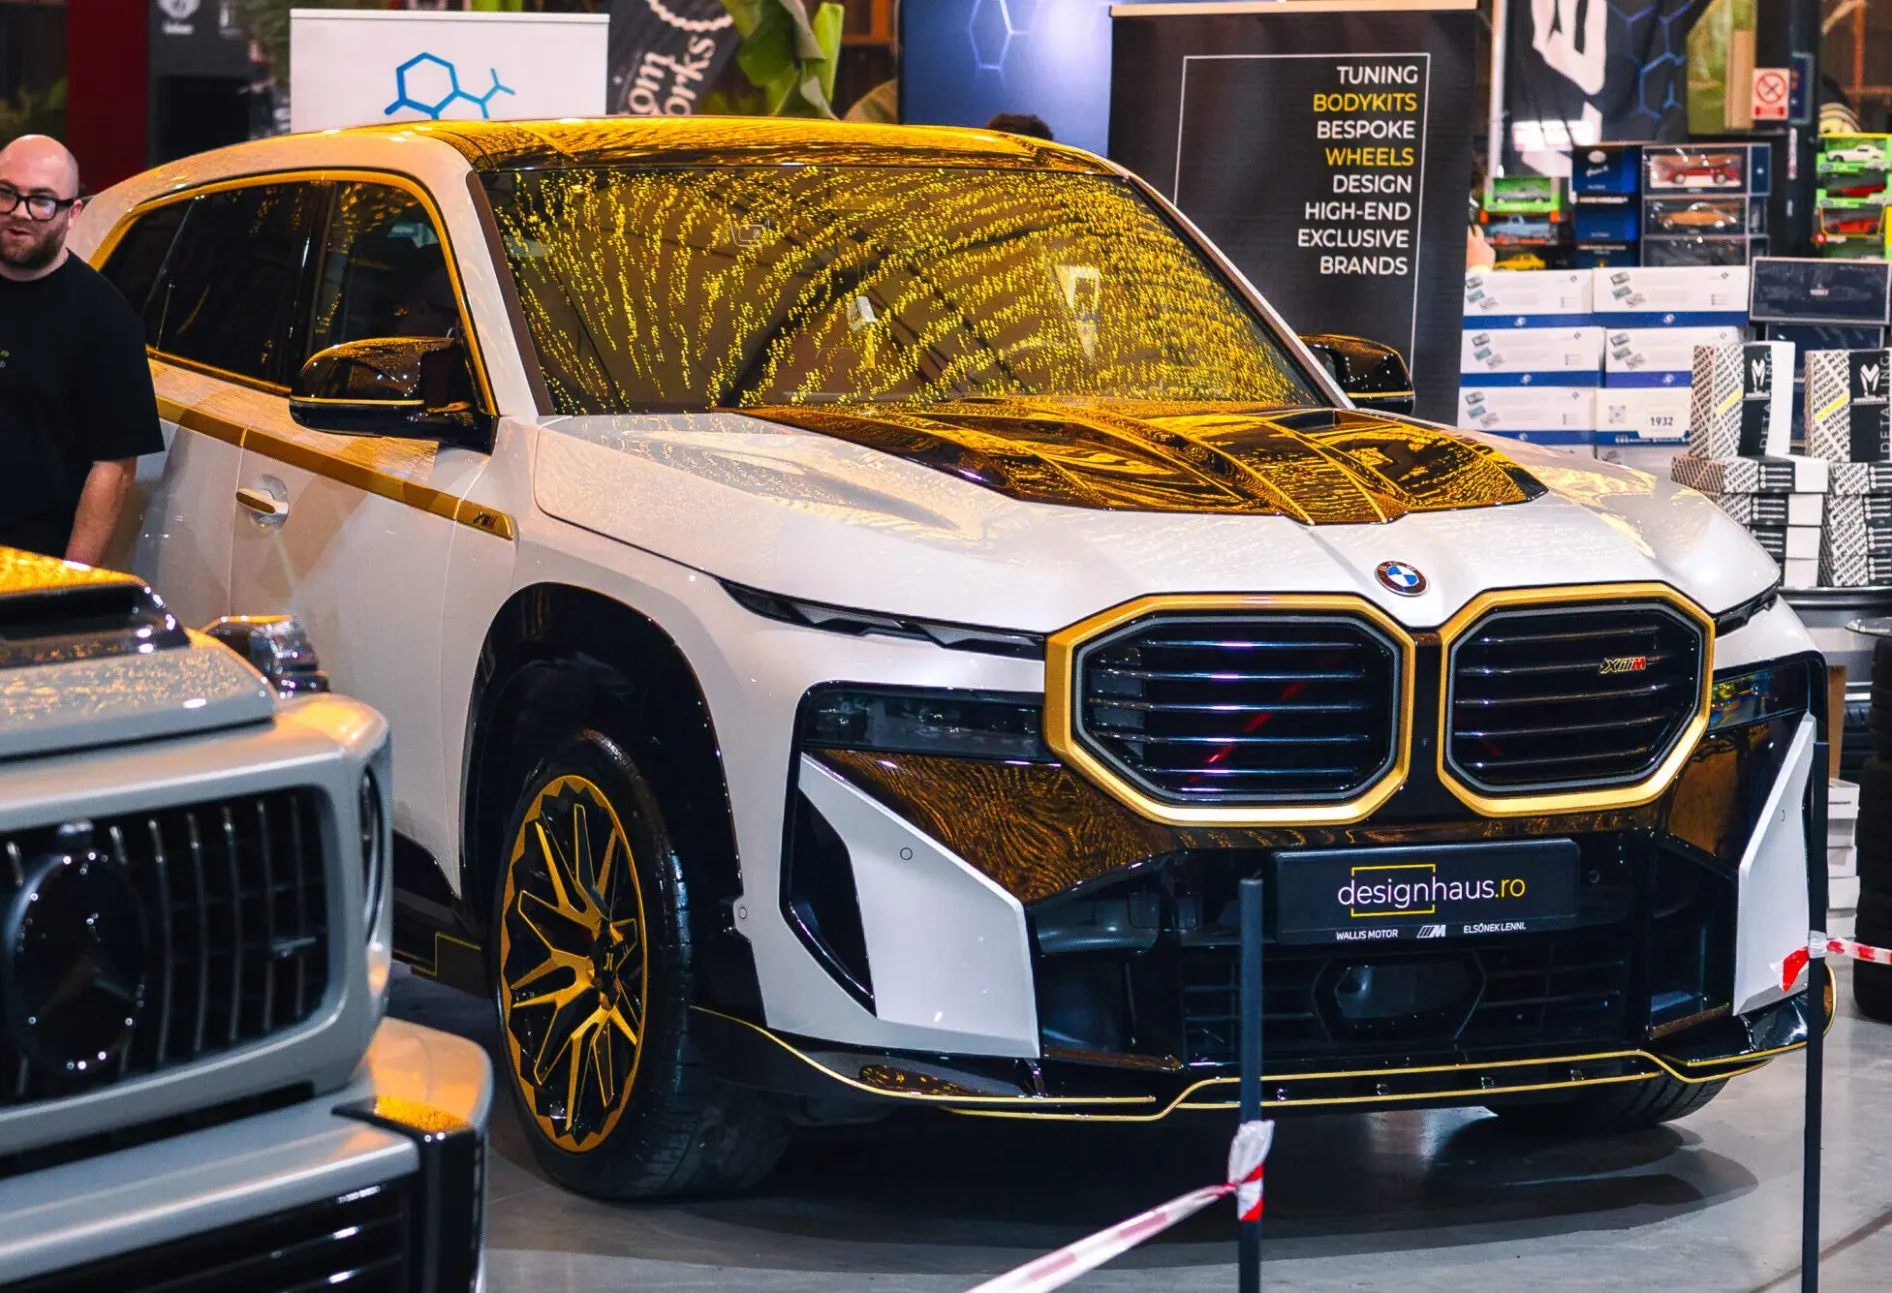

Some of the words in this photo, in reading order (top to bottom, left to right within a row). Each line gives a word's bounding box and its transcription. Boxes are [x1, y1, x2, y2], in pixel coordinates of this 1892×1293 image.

[1336, 65, 1418, 85] TUNING
[1313, 93, 1418, 112] BODYKITS
[1316, 120, 1416, 139] BESPOKE
[1325, 147, 1414, 167] WHEELS
[1333, 174, 1412, 193] DESIGN
[1304, 201, 1411, 221] HIGH-END
[1298, 228, 1410, 248] EXCLUSIVE
[1320, 256, 1408, 275] BRANDS
[1650, 416, 1674, 426] 1932
[1337, 876, 1526, 908] designhaus.ro
[1336, 930, 1366, 940] WALLIS
[1368, 929, 1399, 939] MOTOR
